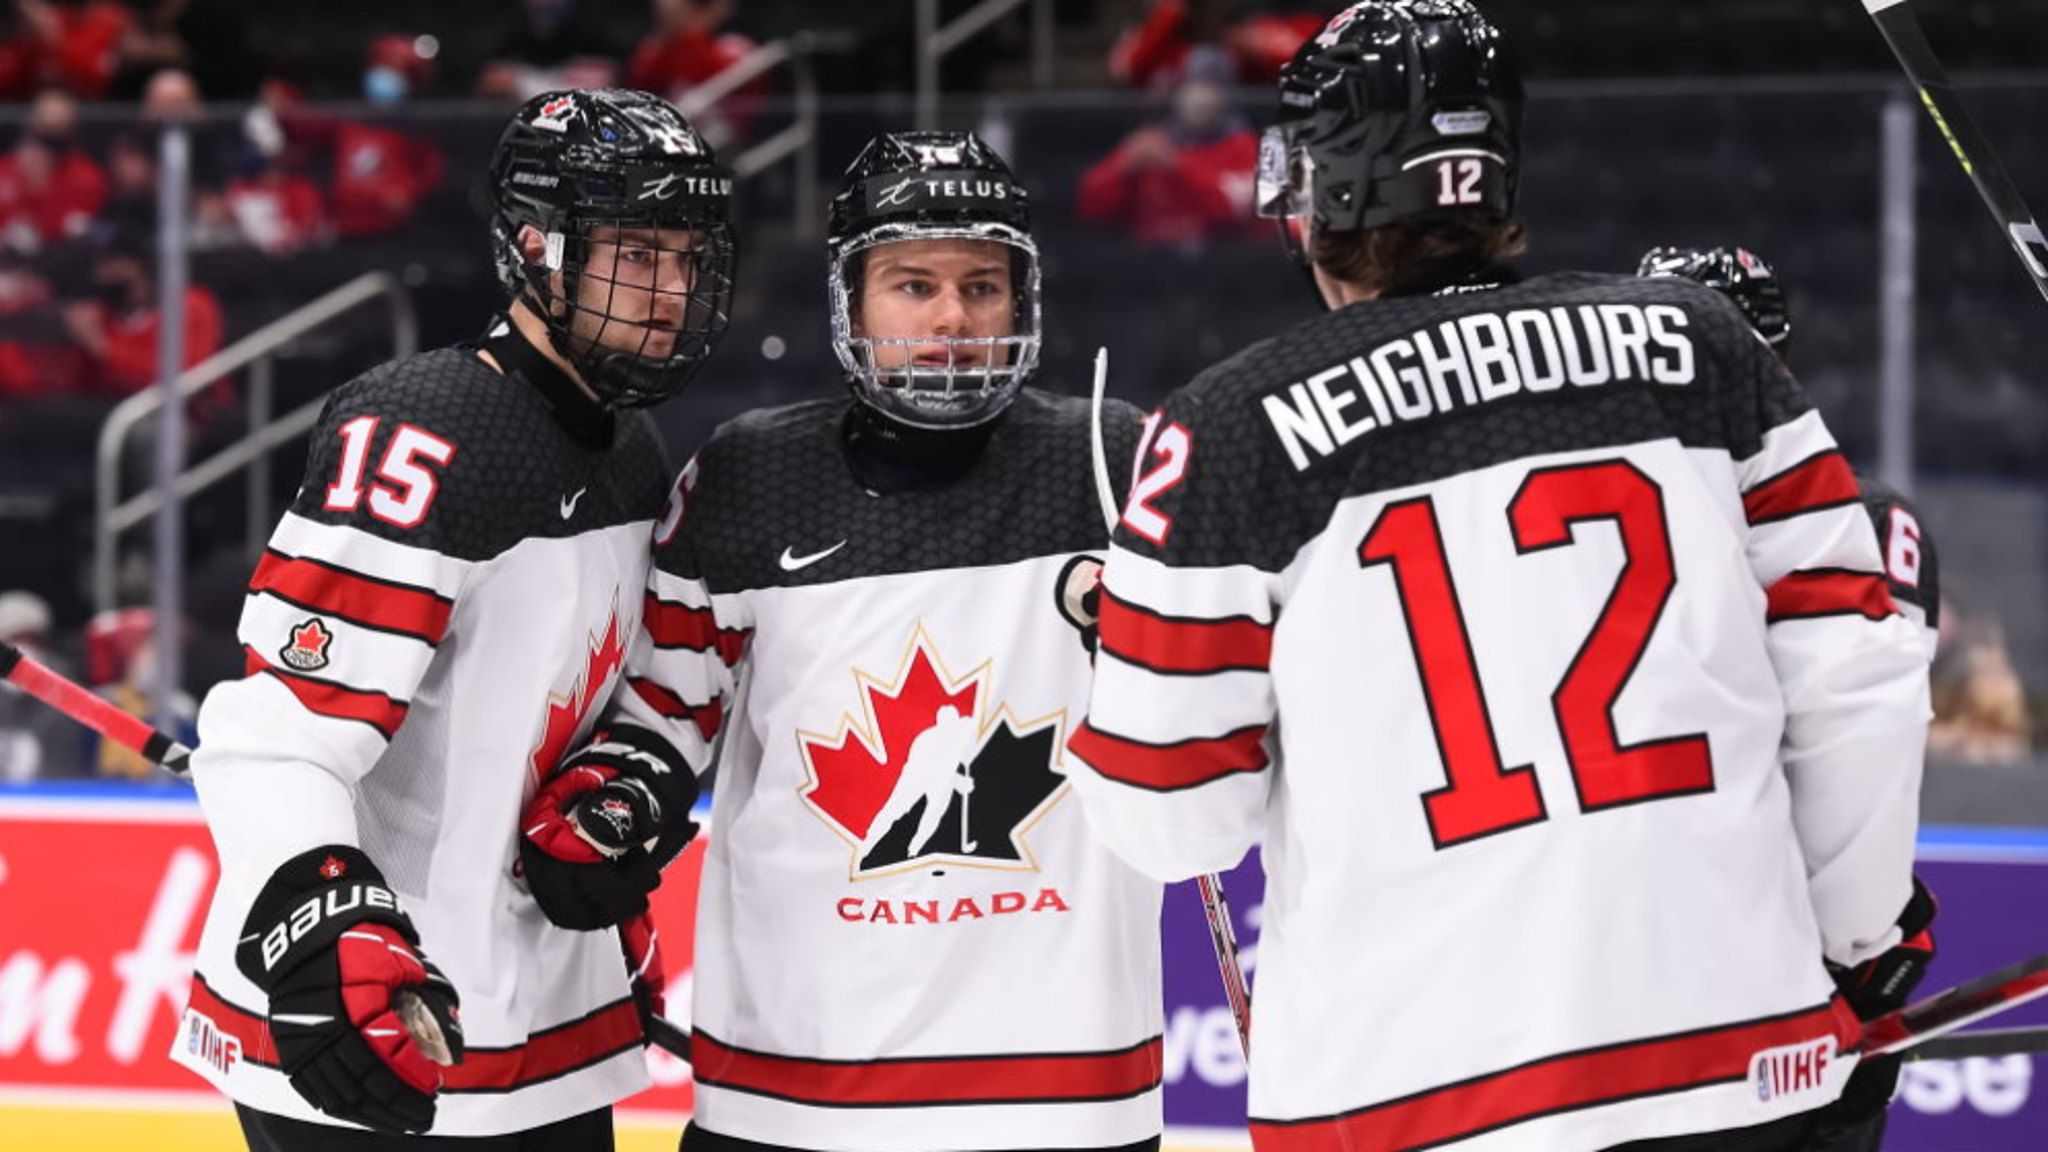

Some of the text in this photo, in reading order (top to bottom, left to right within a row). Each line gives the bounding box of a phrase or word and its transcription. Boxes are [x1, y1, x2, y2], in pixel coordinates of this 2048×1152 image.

[685, 177, 732, 196] TELU
[926, 180, 1007, 199] TELUS
[1437, 159, 1482, 205] 12
[1262, 304, 1696, 472] NEIGHBOURS
[322, 414, 458, 530] 15
[1356, 456, 1716, 851] 12
[836, 888, 1071, 925] CANADA
[201, 1022, 238, 1075] IIHF
[1773, 1043, 1829, 1097] IIHF
